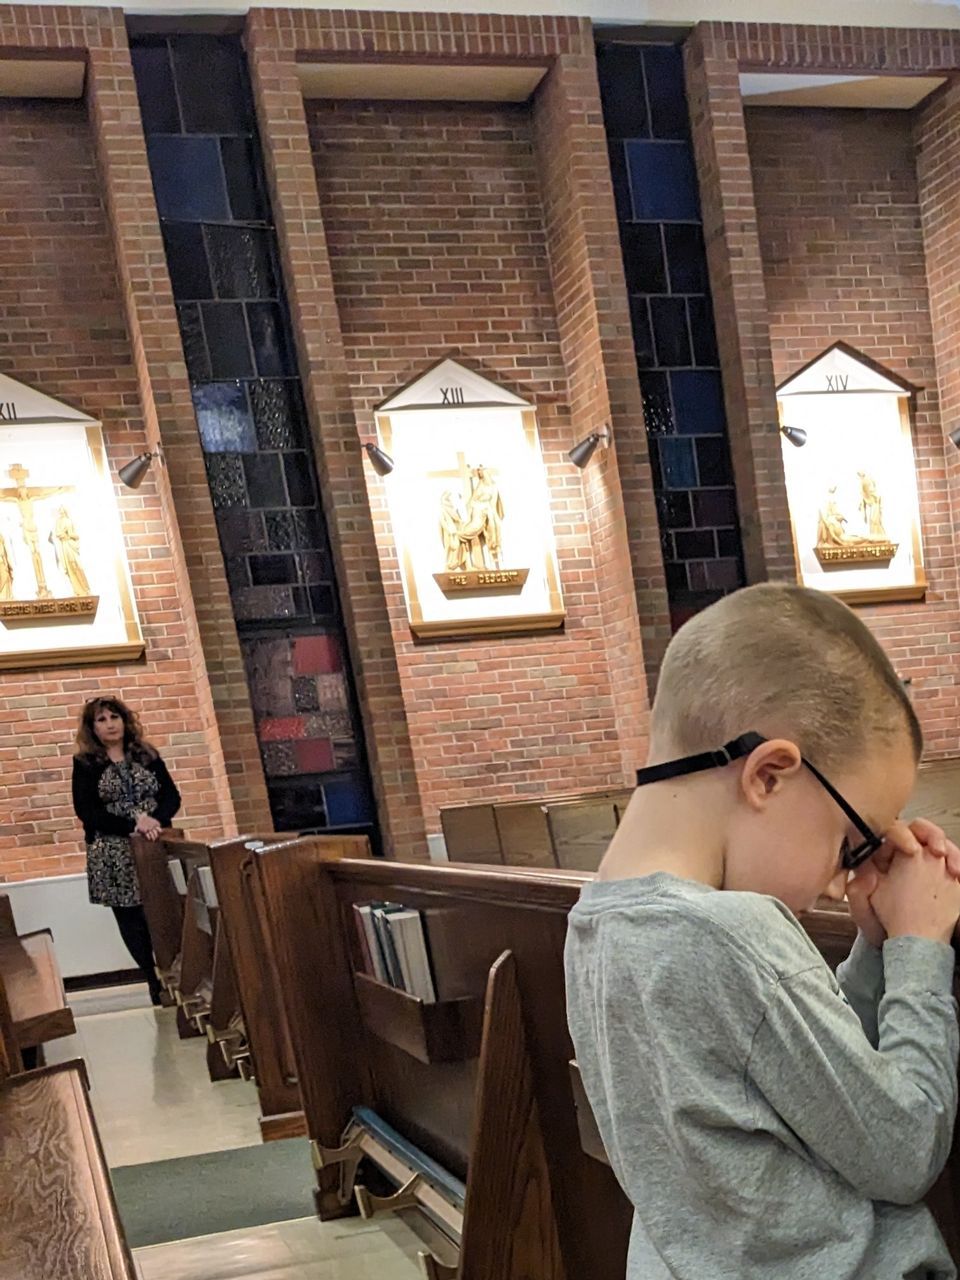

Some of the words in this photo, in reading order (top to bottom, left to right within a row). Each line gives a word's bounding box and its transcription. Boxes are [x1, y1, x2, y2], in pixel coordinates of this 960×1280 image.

[826, 375, 848, 391] XIV
[440, 387, 464, 405] XIII
[449, 575, 467, 585] THE
[3, 604, 31, 616] JESUS
[57, 600, 78, 613] FOR
[80, 599, 93, 611] US
